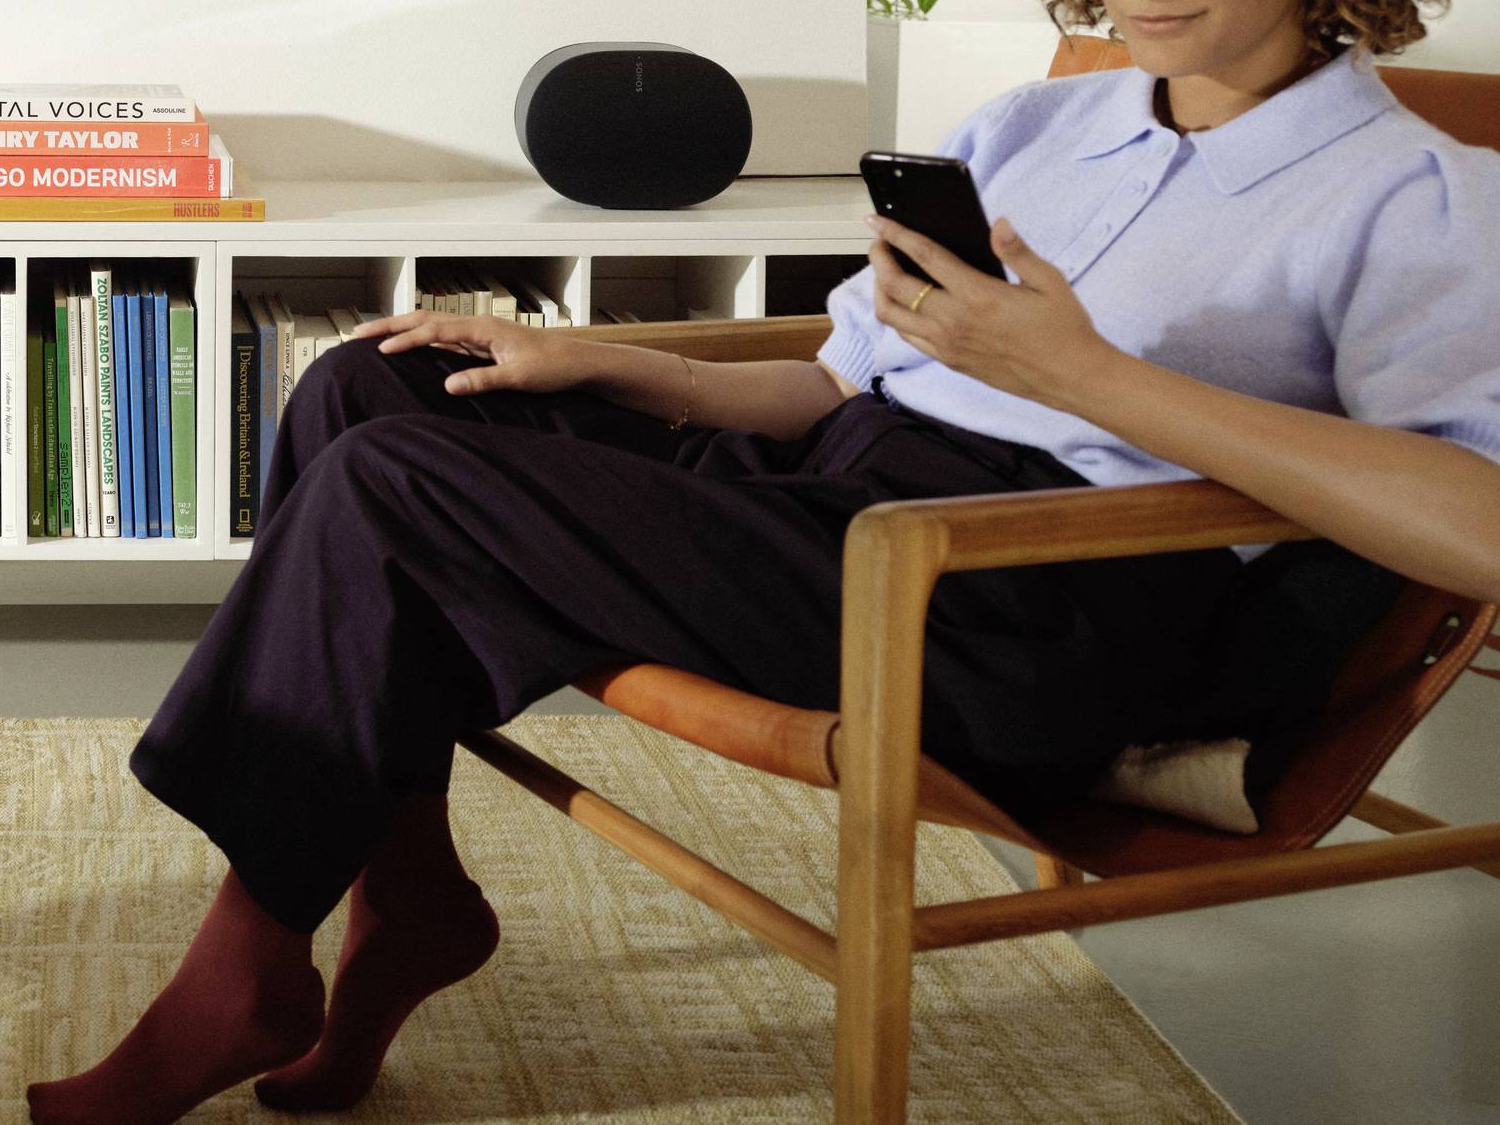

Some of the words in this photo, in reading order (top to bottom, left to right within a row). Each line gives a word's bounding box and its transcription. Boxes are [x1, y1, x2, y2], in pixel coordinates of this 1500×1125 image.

[636, 62, 644, 92] SONOS
[49, 101, 144, 119] VOICES
[43, 130, 139, 149] TAYLOR
[33, 167, 177, 189] MODERNISM
[207, 163, 216, 192] TASCHEN
[173, 202, 220, 218] HUSTLERS
[97, 278, 108, 322] ZOLTAN
[98, 324, 110, 364] SZABO
[46, 357, 55, 390] Travelling
[100, 366, 111, 406] PAINTS
[237, 351, 251, 412] Discovering
[47, 398, 55, 416] Train
[102, 409, 114, 485] LANDSCAPES
[239, 413, 251, 449] Britain
[48, 434, 56, 468] Edwardian
[239, 449, 251, 461] &
[60, 442, 72, 506] sampler2
[239, 461, 251, 498] Ireland
